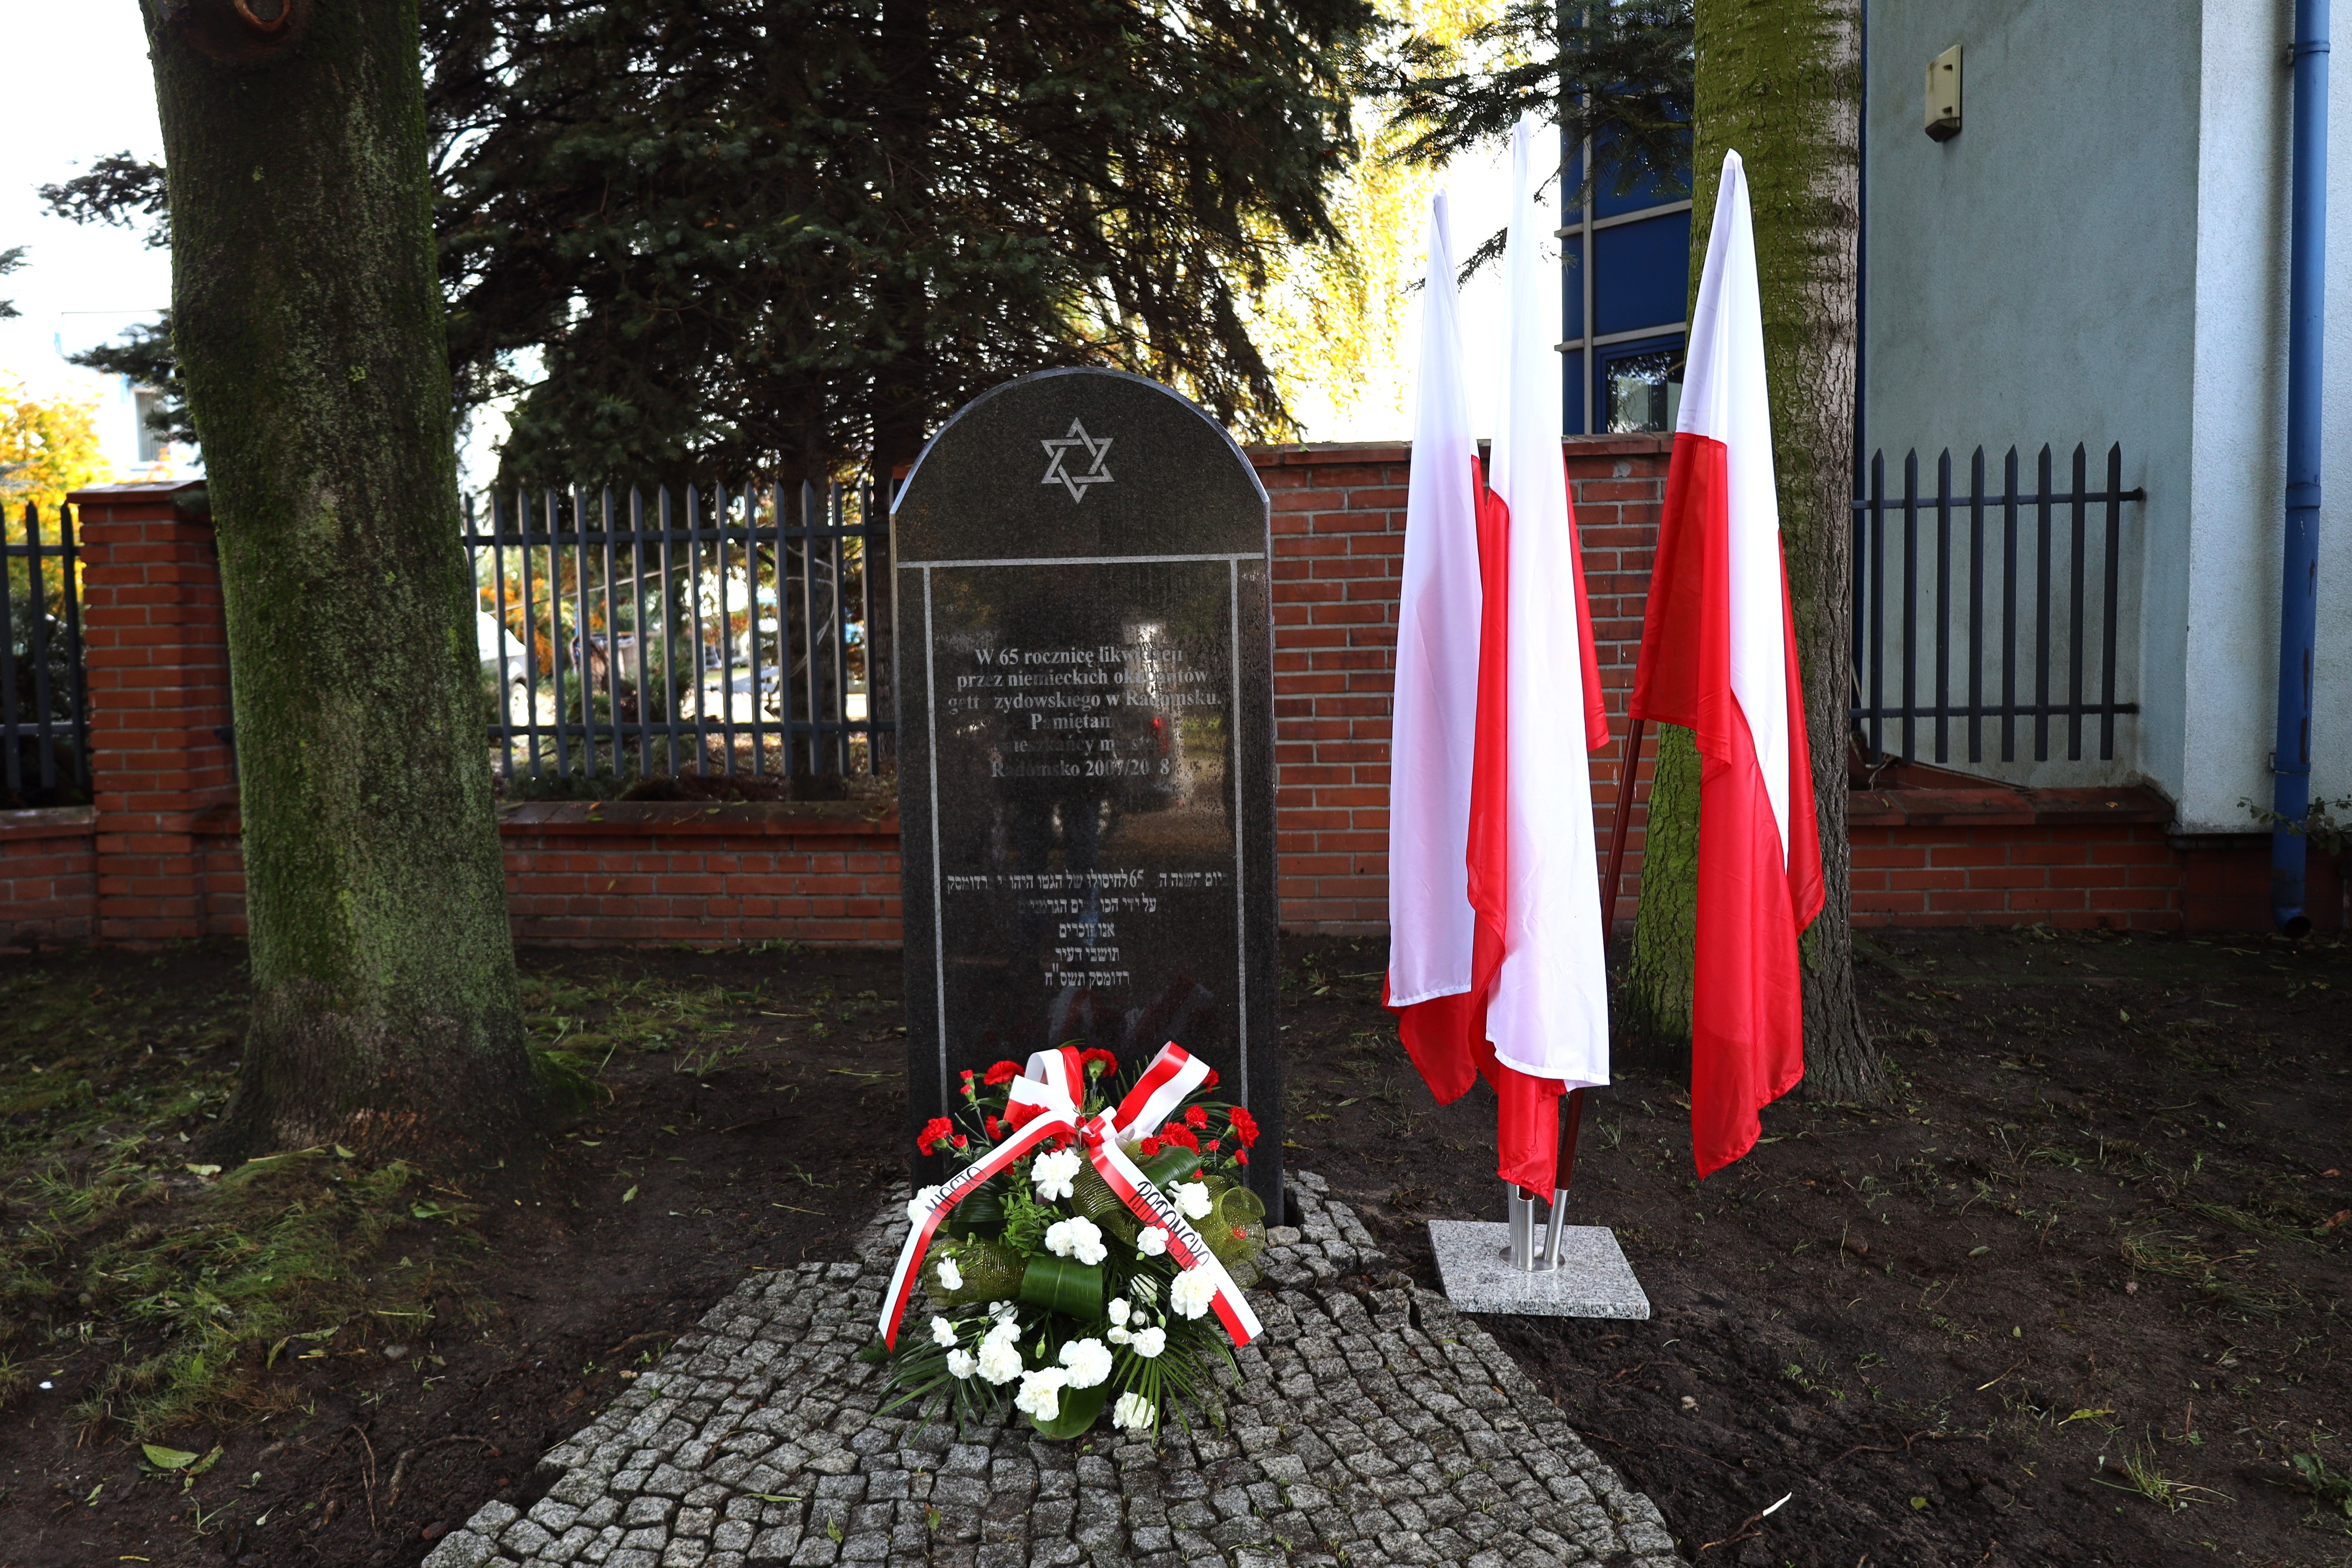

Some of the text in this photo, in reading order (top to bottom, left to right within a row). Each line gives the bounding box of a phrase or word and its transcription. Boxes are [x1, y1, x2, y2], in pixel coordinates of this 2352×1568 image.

[975, 648, 994, 665] W
[999, 648, 1019, 665] 65
[1025, 647, 1094, 668] rocznicę
[957, 674, 1003, 692] przez
[1007, 668, 1109, 687] niemieckich
[948, 694, 985, 715] gett
[1106, 694, 1120, 707] w
[1126, 689, 1221, 707] Radomsku.
[1030, 713, 1122, 733] Pamiętam
[991, 758, 1170, 778] Radomsko 2007/208
[997, 874, 1033, 889] היהוי
[1037, 874, 1063, 889] הגטו
[1065, 869, 1083, 889] של
[1171, 872, 1202, 887] השנה
[1071, 897, 1119, 914] הכוים
[1122, 897, 1140, 912] ידי
[1142, 892, 1157, 912] על
[1059, 922, 1116, 938] אנו זוכרים
[1085, 946, 1119, 962] תושבי
[1089, 971, 1130, 989] רדומסק
[925, 1166, 987, 1219] MIASTO
